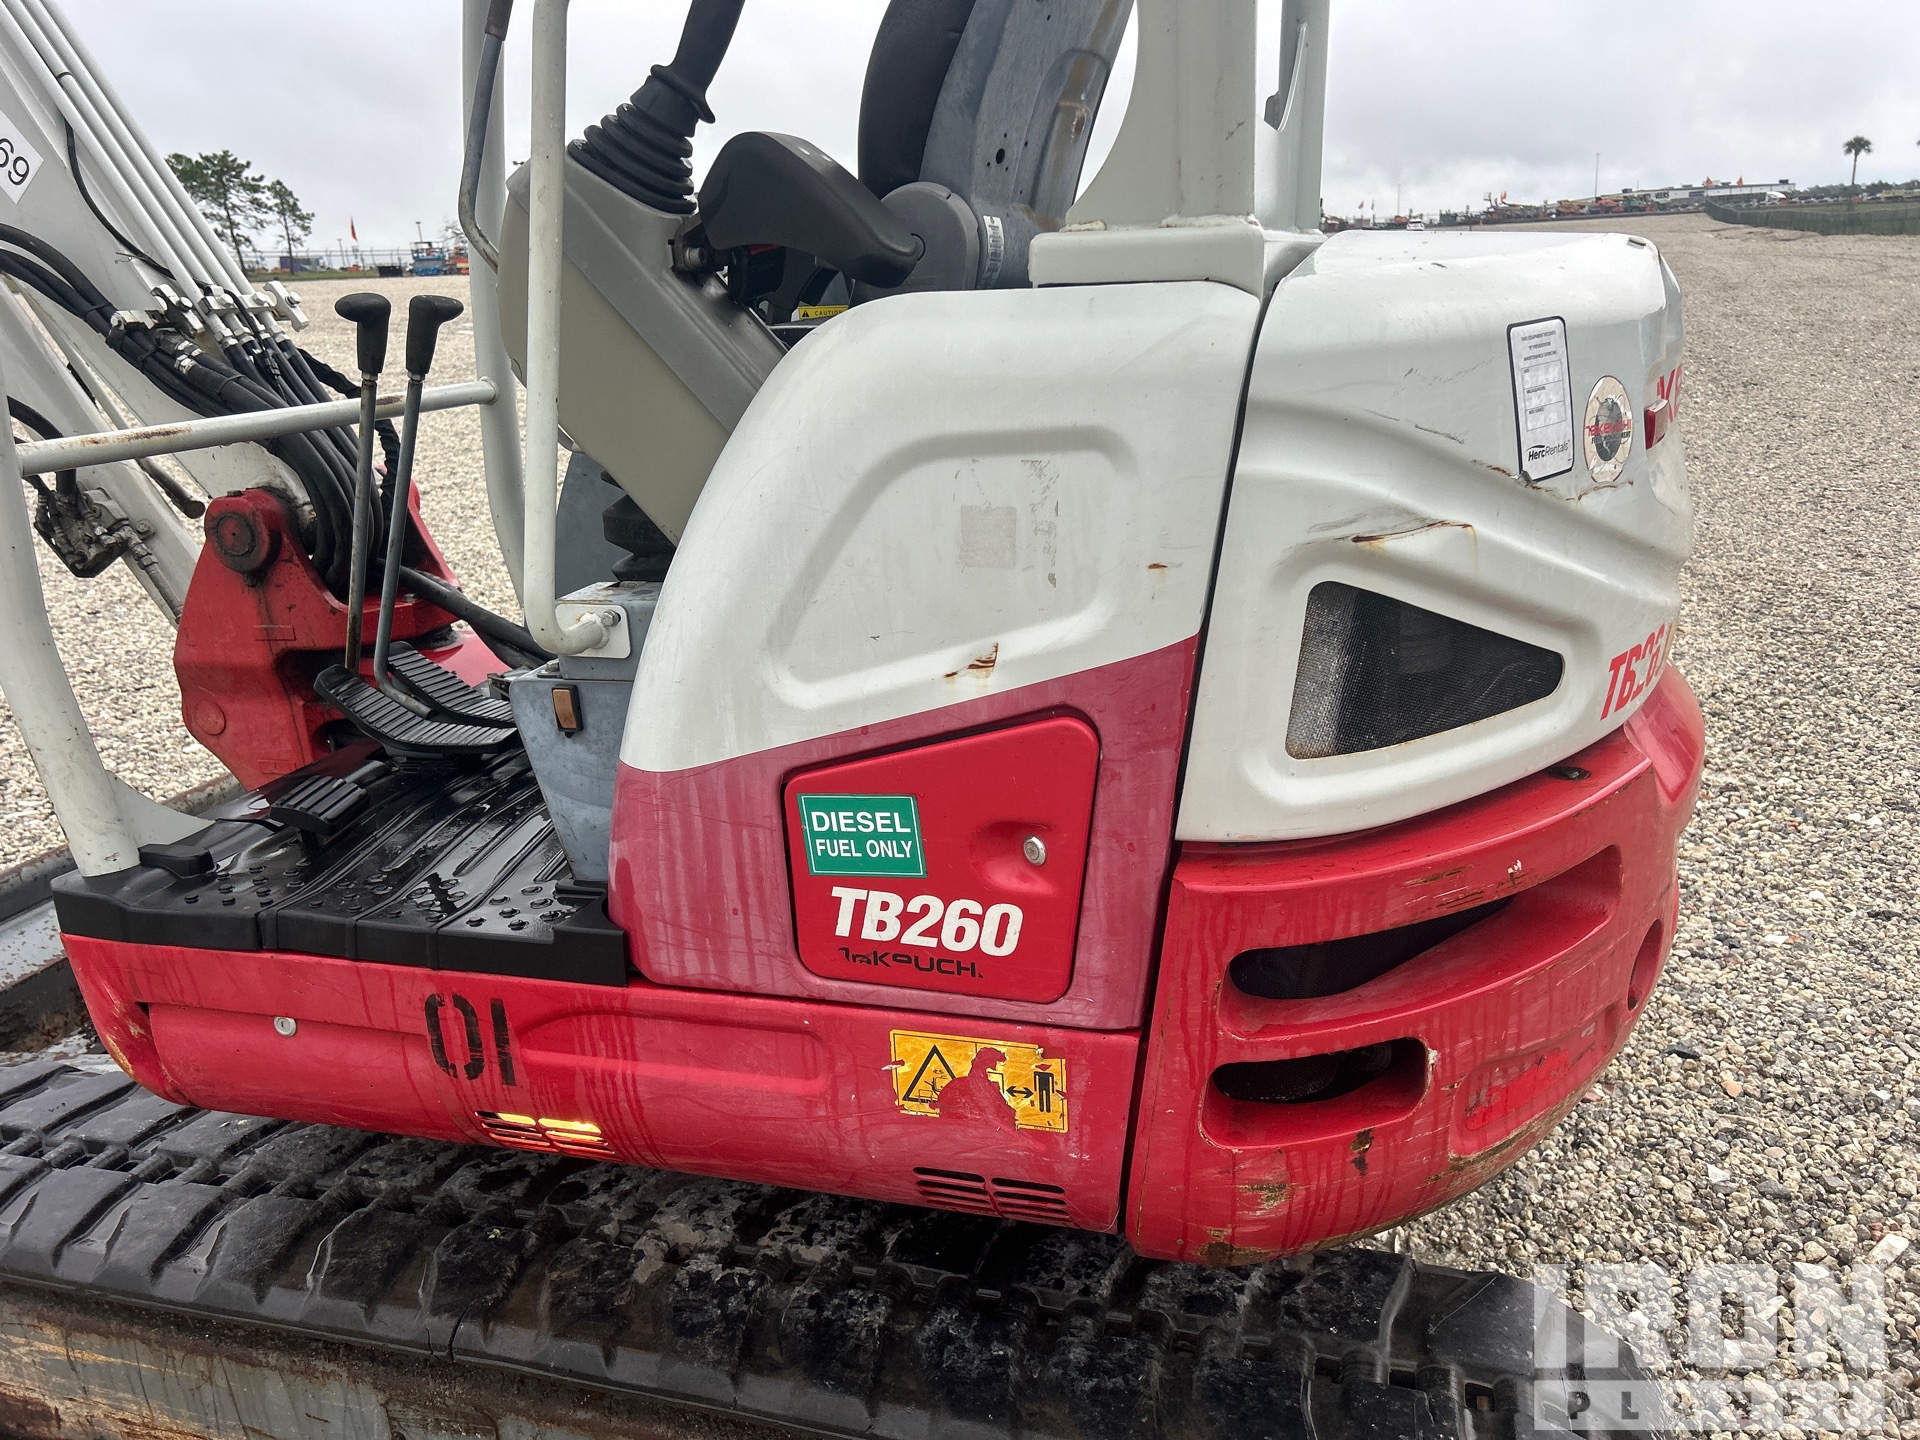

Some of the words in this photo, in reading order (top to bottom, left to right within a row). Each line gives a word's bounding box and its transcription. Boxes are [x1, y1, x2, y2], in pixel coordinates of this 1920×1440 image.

[811, 811, 912, 833] DIESEL
[815, 839, 862, 857] FUEL
[865, 839, 912, 858] ONLY
[831, 886, 1024, 957] TB260
